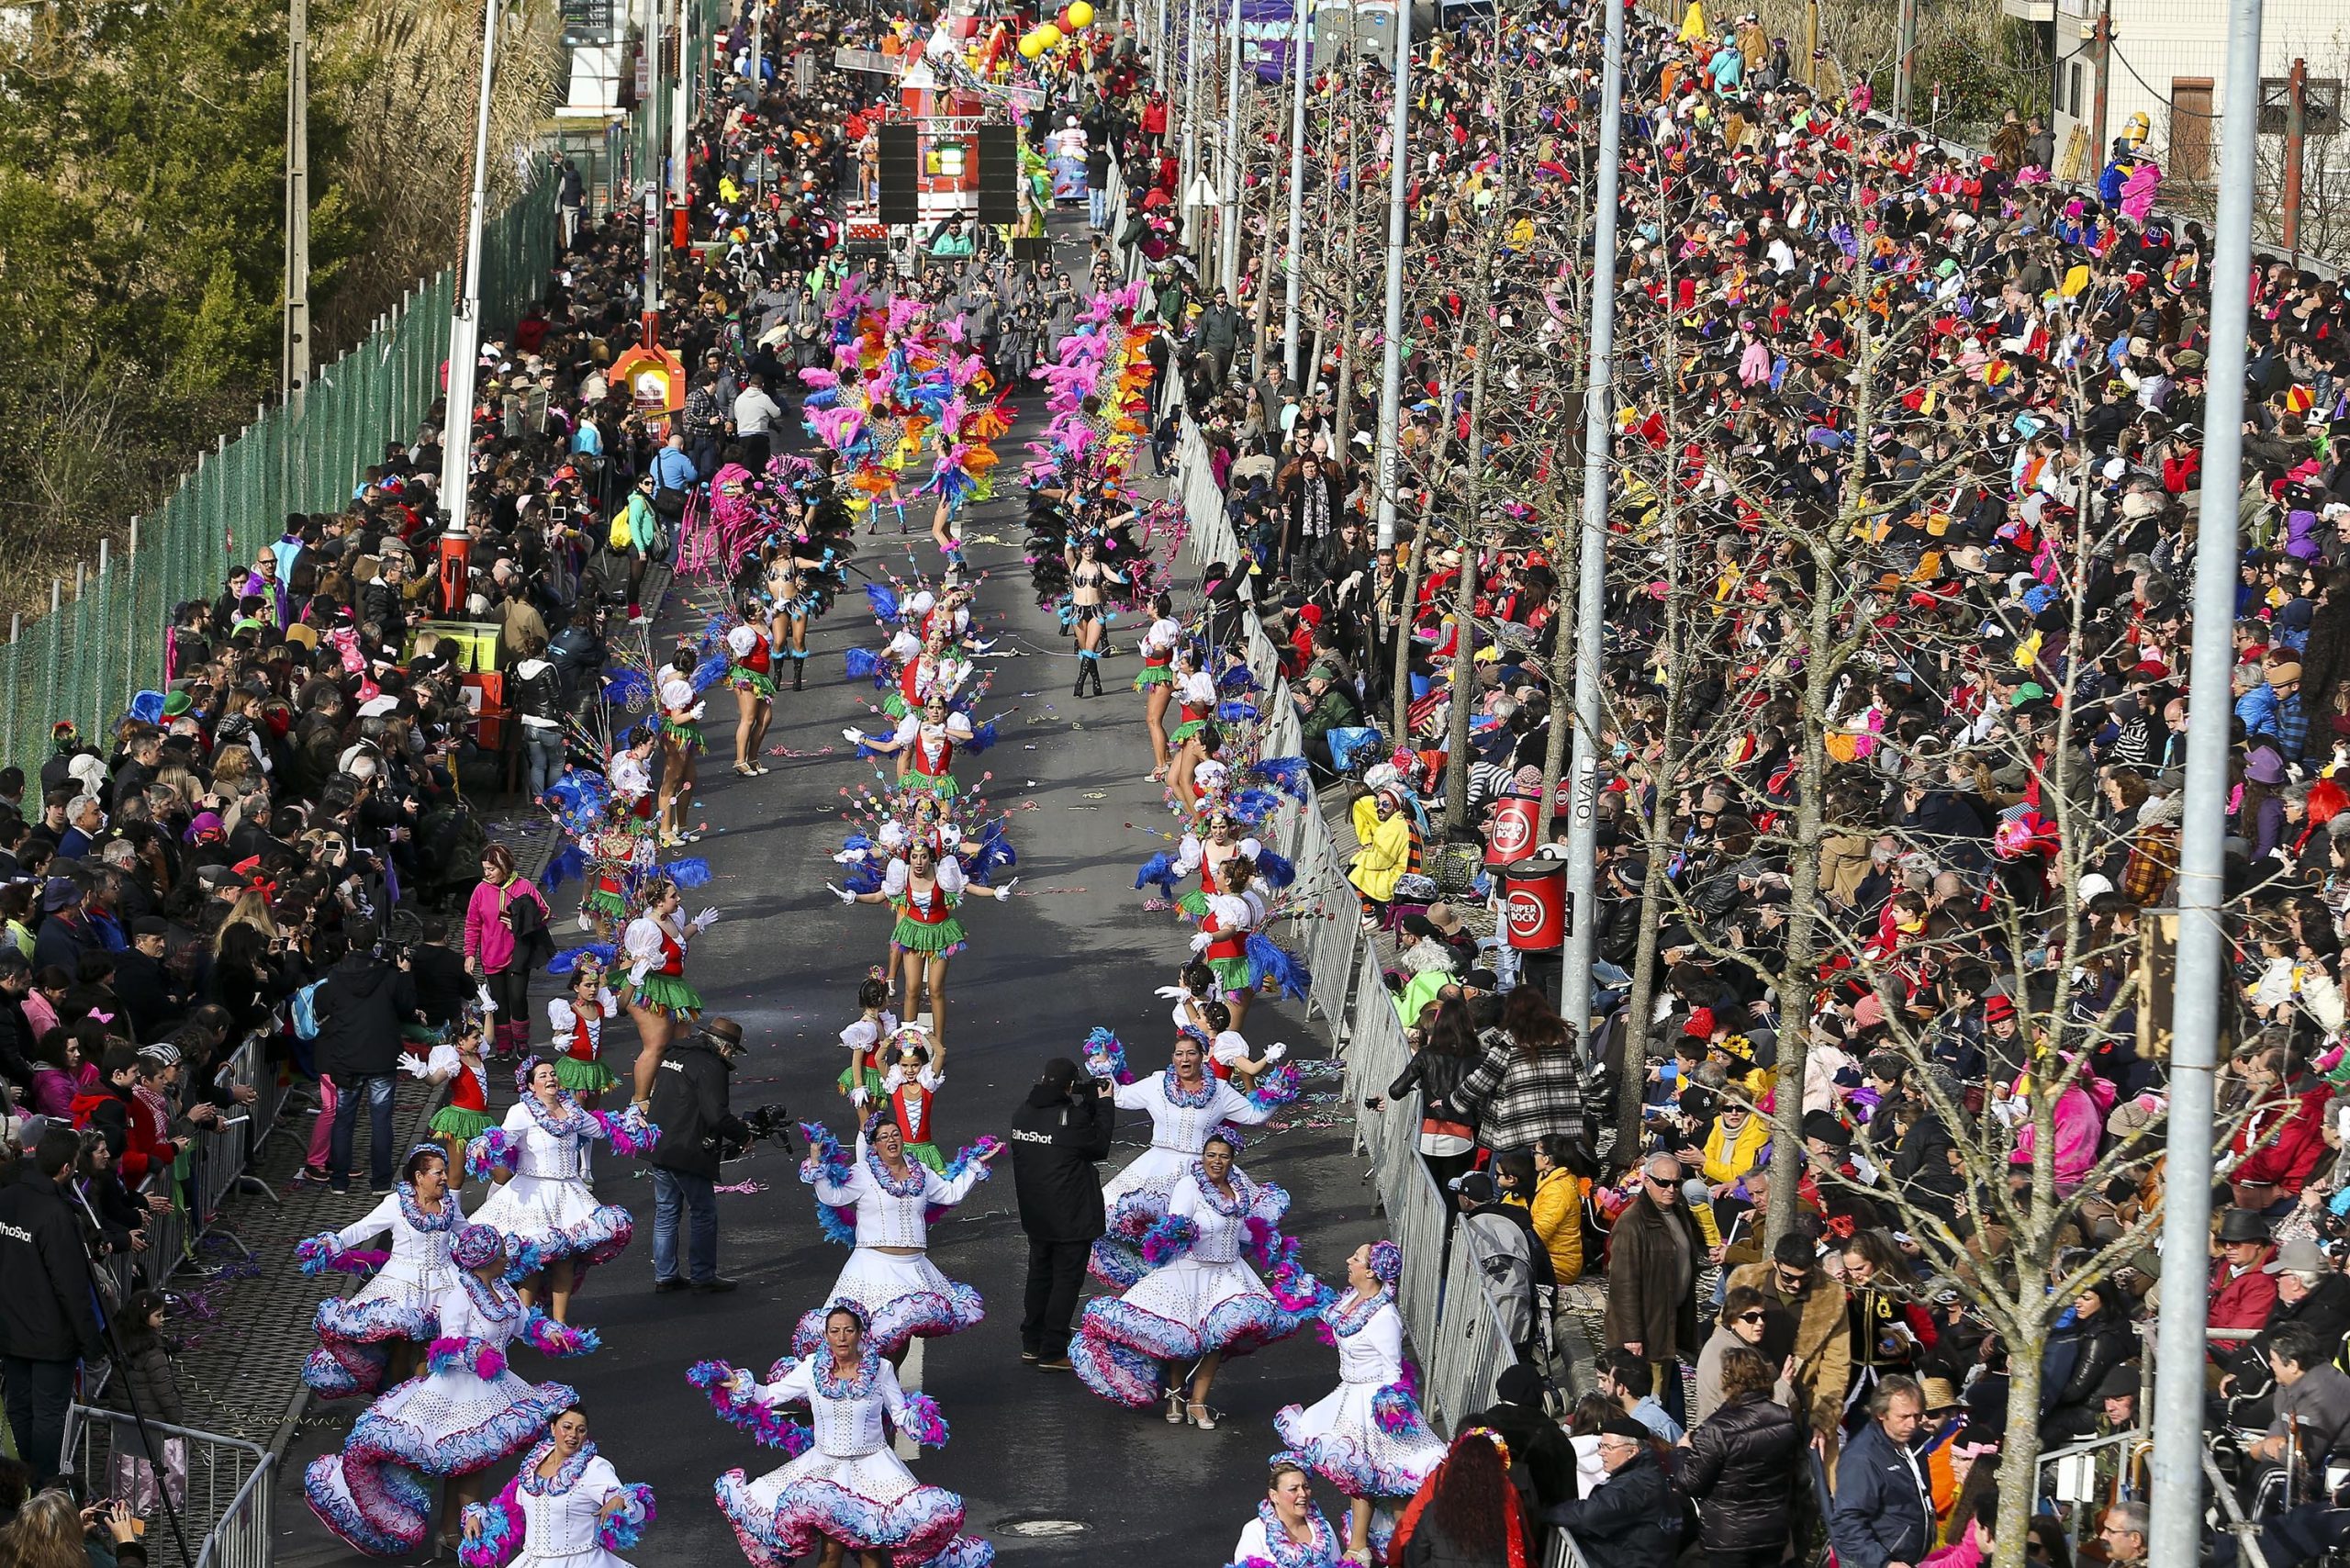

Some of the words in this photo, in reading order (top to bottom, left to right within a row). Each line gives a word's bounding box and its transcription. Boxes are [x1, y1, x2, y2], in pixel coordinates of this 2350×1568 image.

[1496, 821, 1524, 832] SUPER
[1496, 829, 1521, 840] BOCK
[1509, 902, 1537, 913] SUPER
[1511, 912, 1536, 923] BOCK
